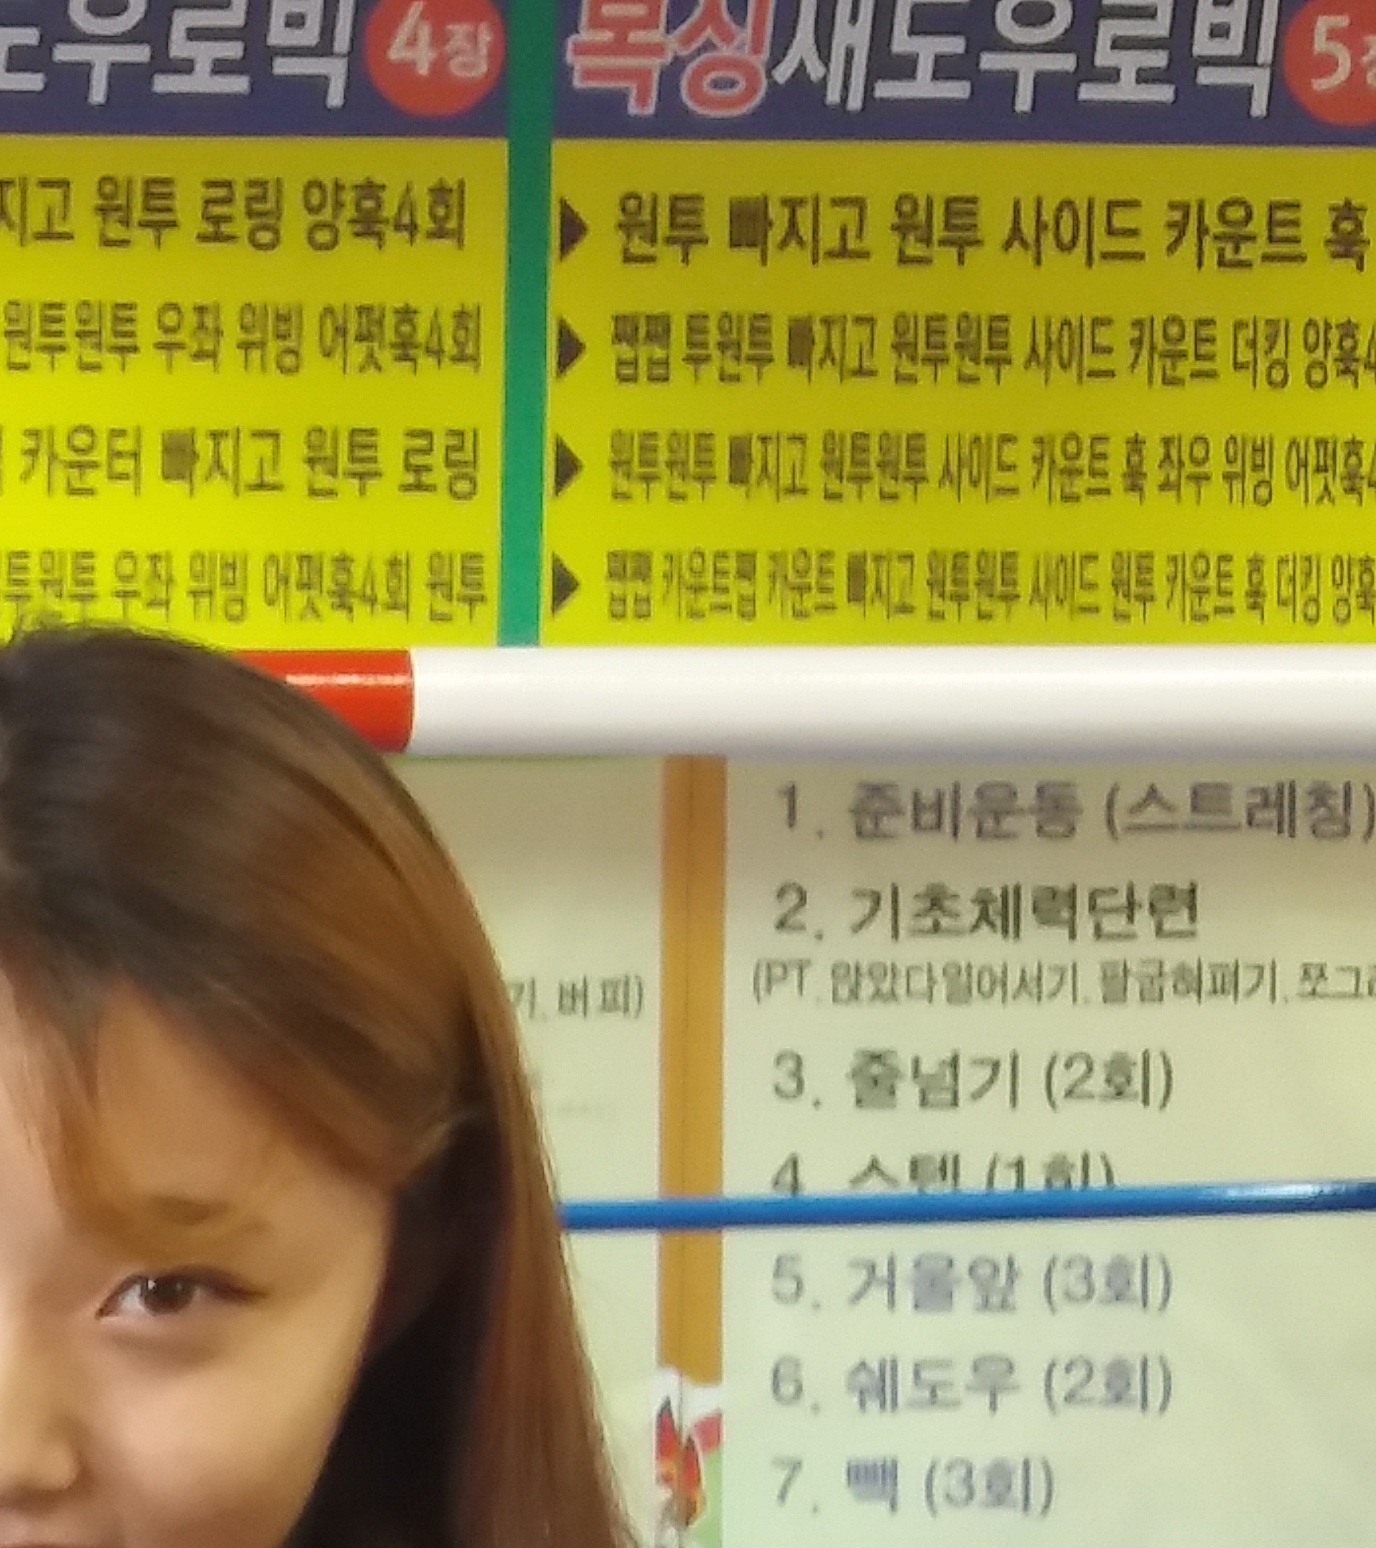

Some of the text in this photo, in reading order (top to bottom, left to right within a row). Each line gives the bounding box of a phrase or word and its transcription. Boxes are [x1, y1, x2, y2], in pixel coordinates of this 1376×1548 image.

[385, 2, 494, 80] 4장
[565, 0, 1278, 117] 복싱새도우로빅
[776, 780, 1376, 842] 1. 준비운동 (스트레칭)
[773, 880, 1200, 943] 2. 기초체력단련
[772, 1048, 1174, 1114] 3. 줄넘기 (2회)
[770, 1250, 1174, 1316] 5. 거울앞 (3회)
[770, 1353, 1174, 1416] 6. 쉐도우 (2회)
[770, 1456, 822, 1516] 7.
[924, 1455, 1055, 1519] (3회)
